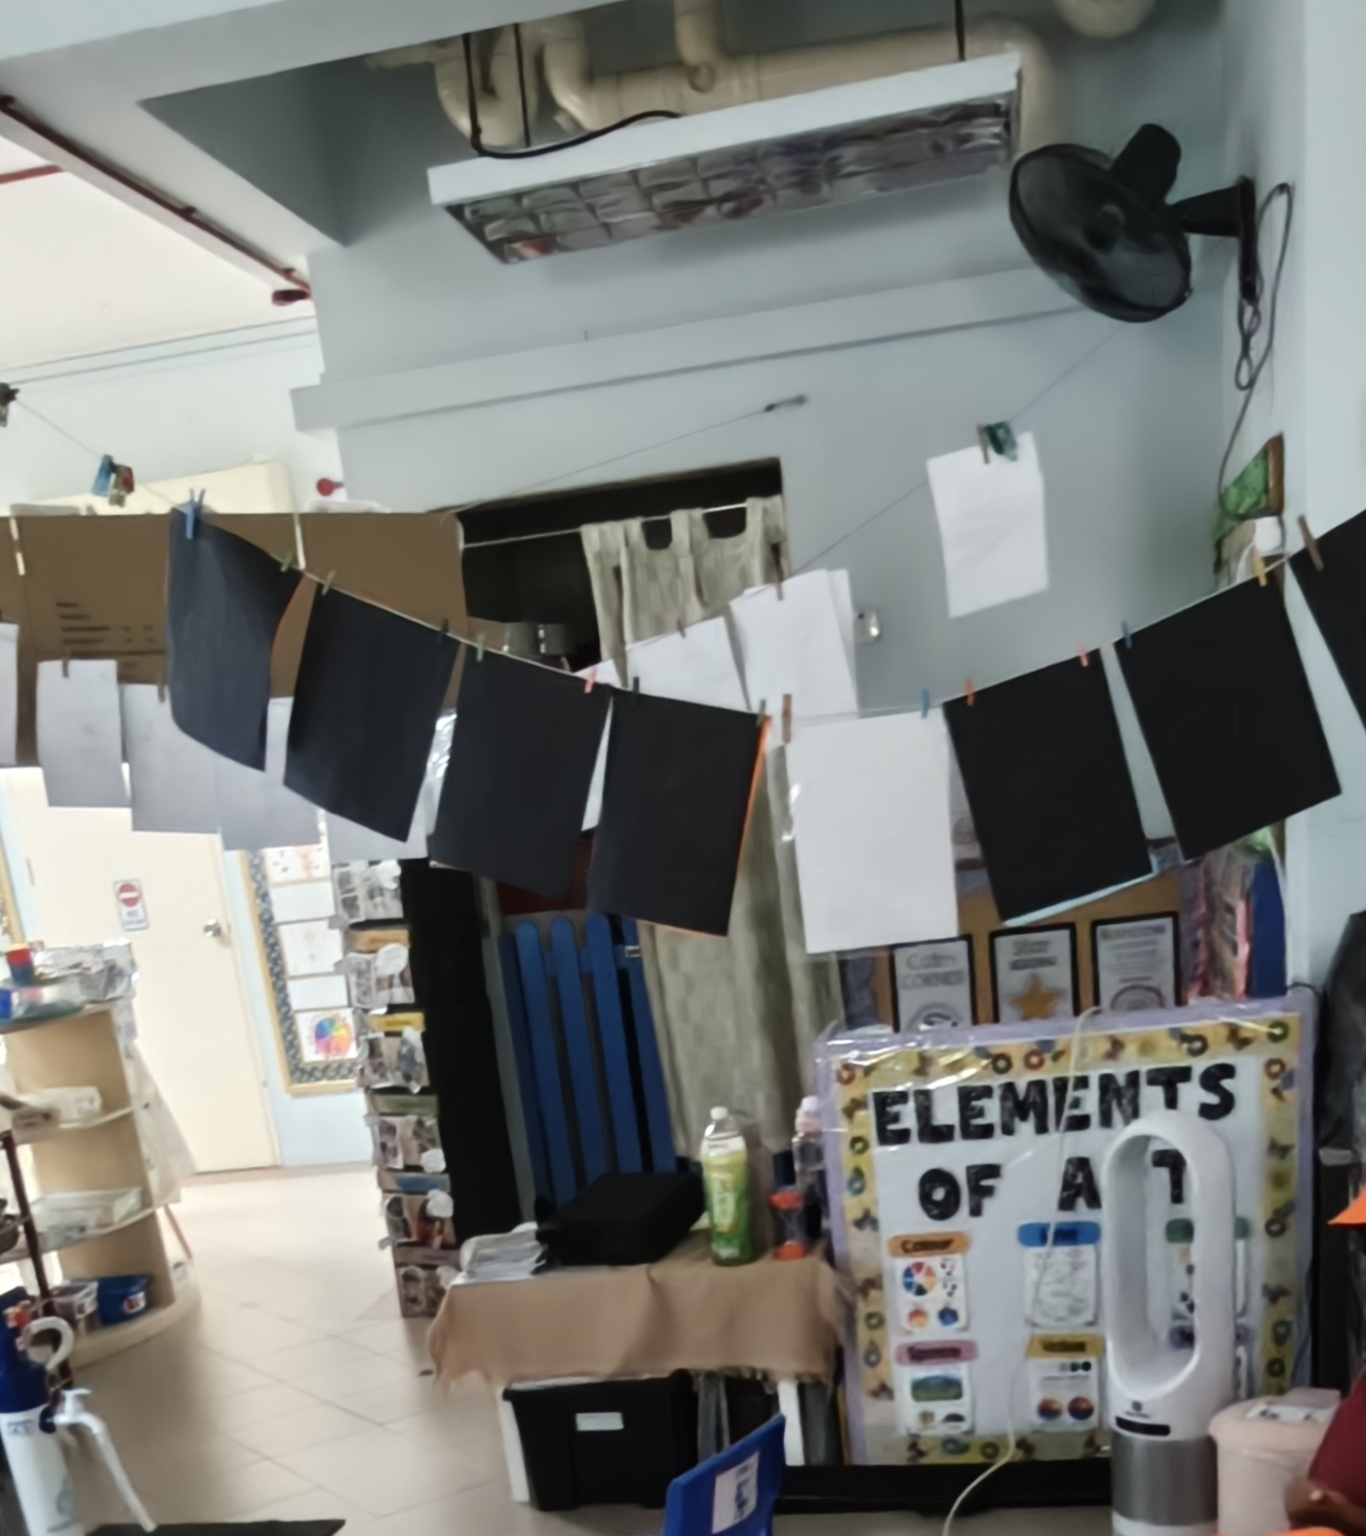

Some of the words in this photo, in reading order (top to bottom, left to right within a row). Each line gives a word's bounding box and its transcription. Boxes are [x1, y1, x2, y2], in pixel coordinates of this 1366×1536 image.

[872, 1062, 1236, 1147] ELEMENTS
[918, 1163, 1002, 1222] OF
[1057, 1148, 1187, 1212] AT
